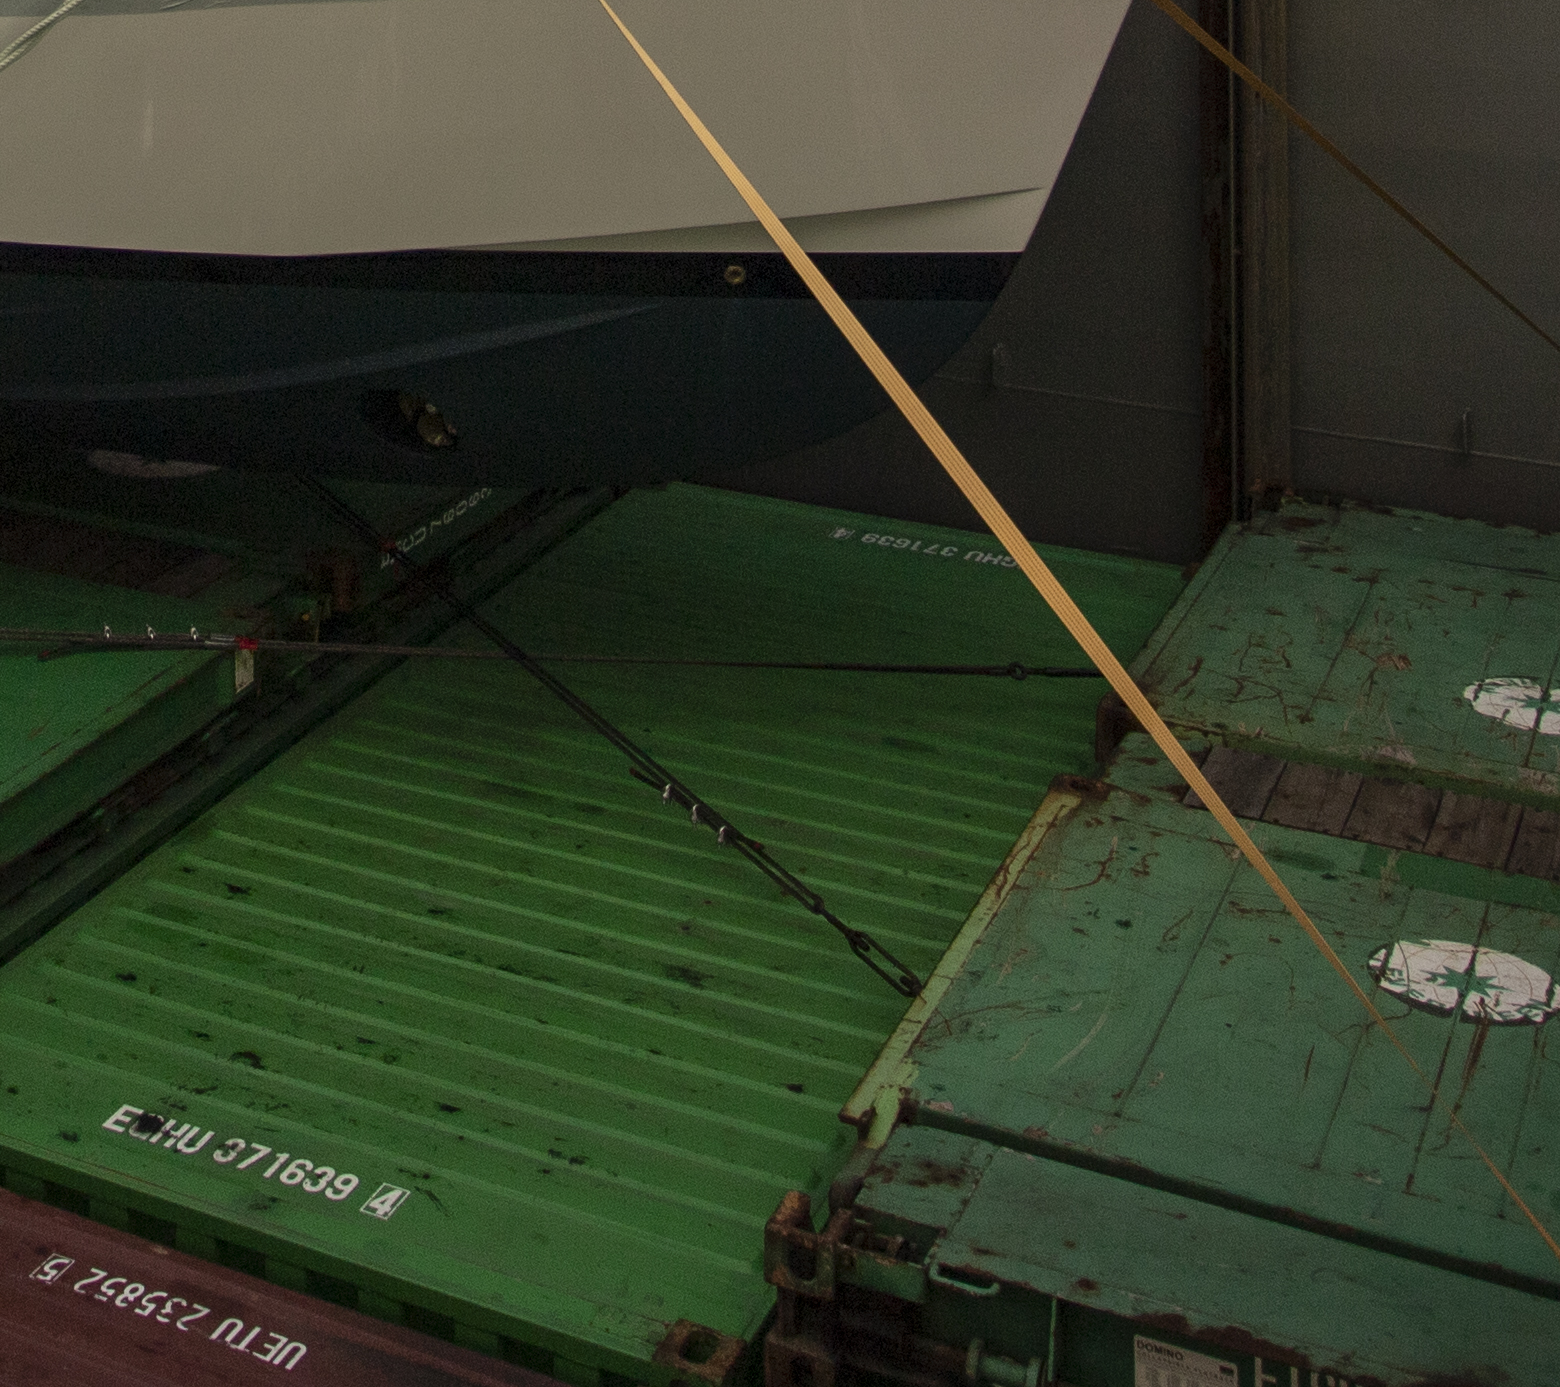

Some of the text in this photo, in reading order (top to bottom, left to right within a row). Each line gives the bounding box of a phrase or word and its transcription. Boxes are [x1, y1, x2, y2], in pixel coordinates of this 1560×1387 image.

[963, 550, 1019, 568] GHU
[213, 1138, 359, 1201] 371639
[74, 1267, 210, 1331] 235852
[209, 1318, 307, 1370] UETU
